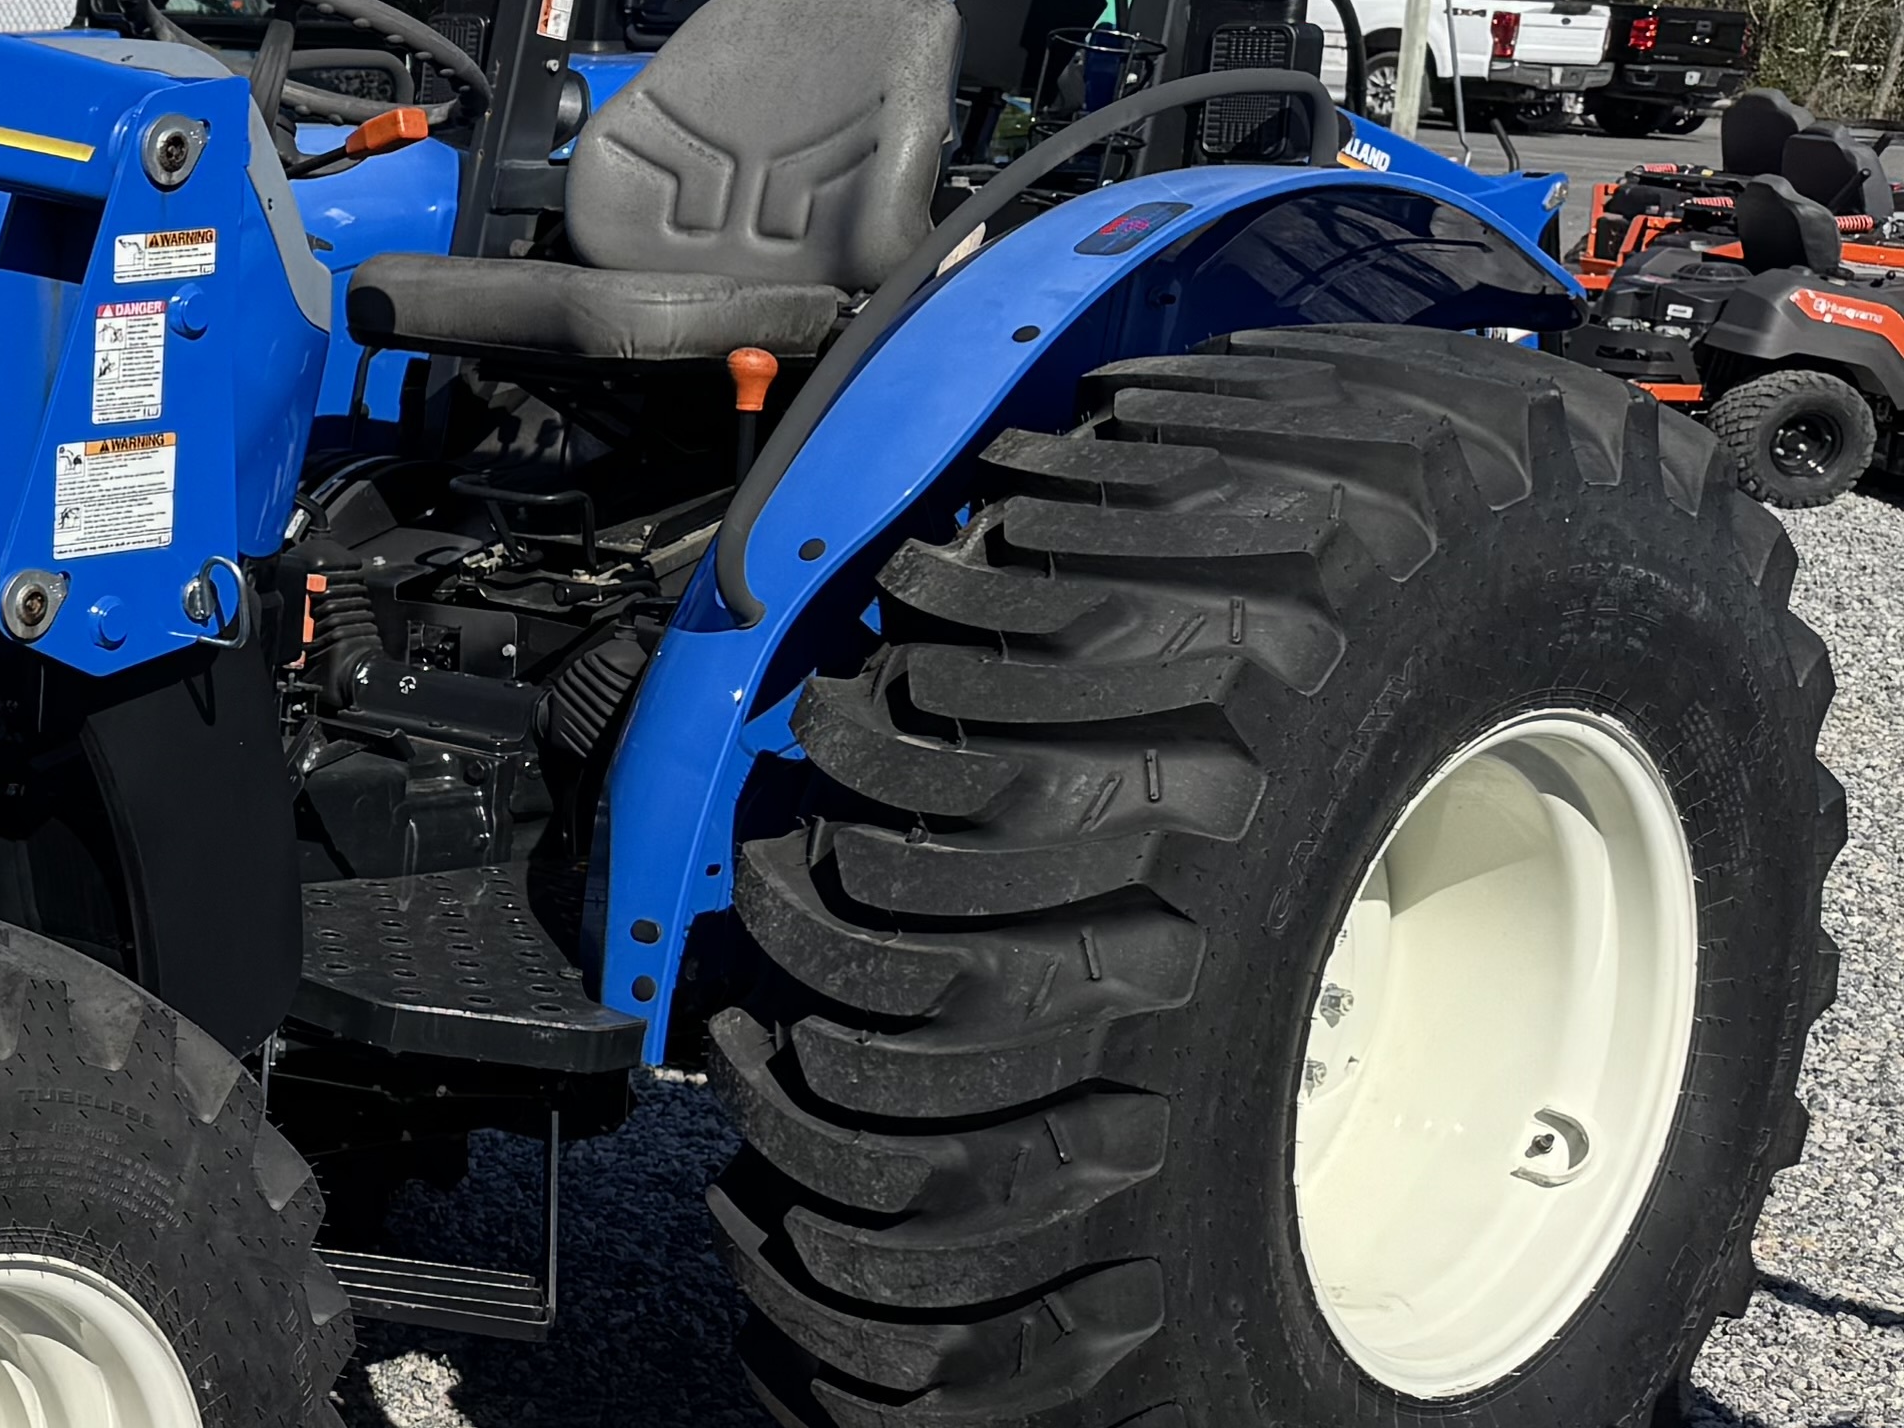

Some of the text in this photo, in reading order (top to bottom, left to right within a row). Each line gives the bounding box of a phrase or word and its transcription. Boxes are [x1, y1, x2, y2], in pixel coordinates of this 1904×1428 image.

[1341, 137, 1391, 173] LLAND
[160, 230, 213, 247] WARNING
[115, 301, 162, 316] DANGER
[111, 434, 165, 452] WARNING
